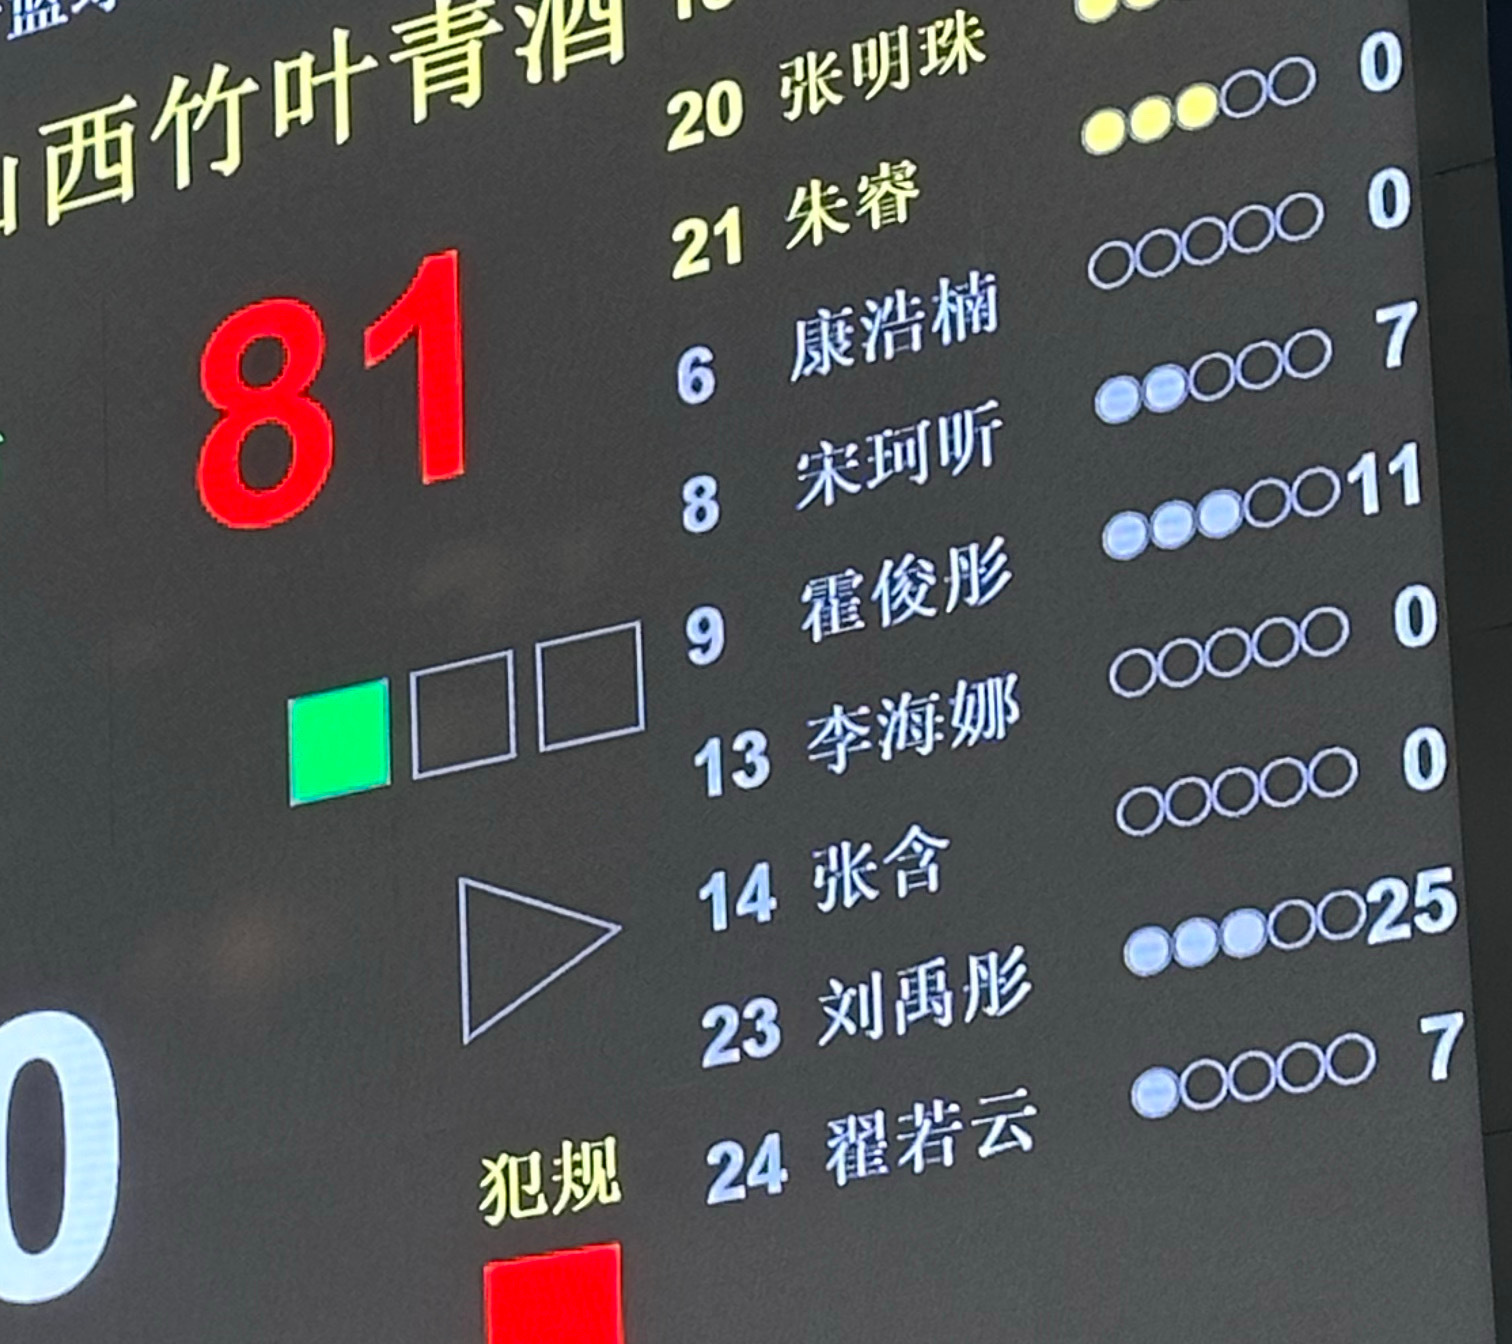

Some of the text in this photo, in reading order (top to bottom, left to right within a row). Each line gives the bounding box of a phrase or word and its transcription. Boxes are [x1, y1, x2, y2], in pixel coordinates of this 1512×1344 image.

[666, 79, 744, 152] 20
[779, 8, 987, 122] 张明珠
[671, 30, 1403, 280] 21 朱睿 0
[195, 248, 466, 530] 81
[677, 167, 1411, 405] 6 康浩楠 0
[682, 300, 1418, 534] 8 宋珂昕 7
[685, 441, 1421, 666] 9 霍俊彤 11
[694, 584, 1438, 798] 13 李海娜 0
[698, 726, 1447, 932] 14 张含 0
[701, 866, 1458, 1069] 23 刘禹彤 25
[478, 1136, 622, 1227] 犯规
[706, 1011, 1465, 1205] 24 翟若云 7
